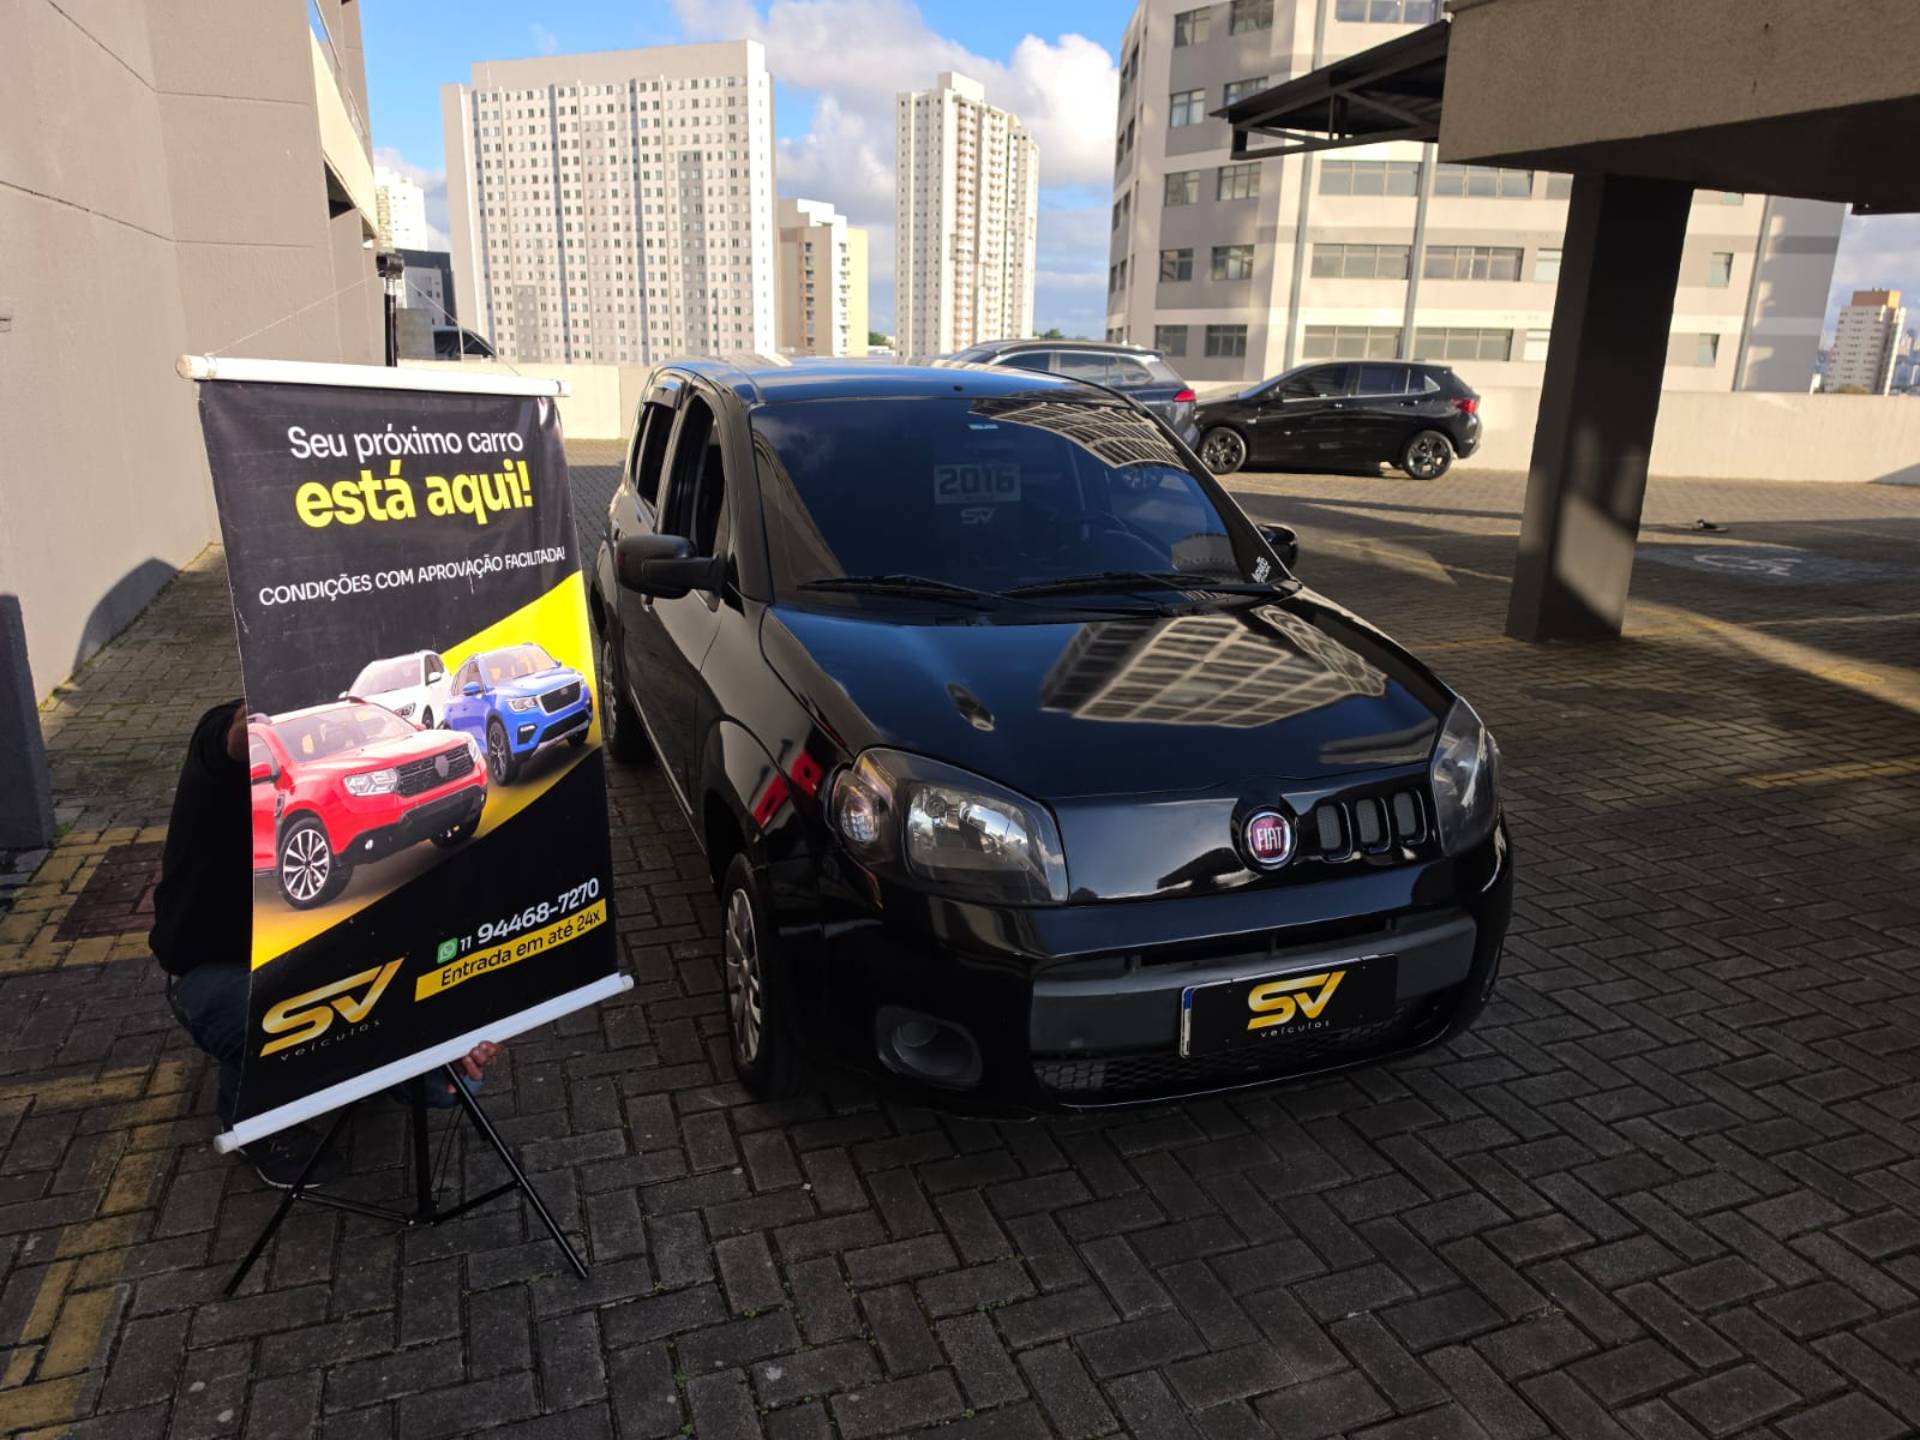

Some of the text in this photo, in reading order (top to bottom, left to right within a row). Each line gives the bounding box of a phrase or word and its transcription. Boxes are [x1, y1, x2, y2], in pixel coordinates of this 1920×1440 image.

[287, 423, 524, 463] Seu próximo carro
[295, 458, 535, 528] está aqui!
[938, 467, 1017, 495] 2016
[258, 545, 566, 607] CONDIÇÕES COM APROVAÇÃO FACILITADA!
[1256, 826, 1283, 851] FIAT
[477, 877, 600, 945] 94468-7270
[440, 909, 601, 987] Entrada em até 24x
[260, 957, 405, 1057] SV
[1247, 970, 1347, 1030] SV
